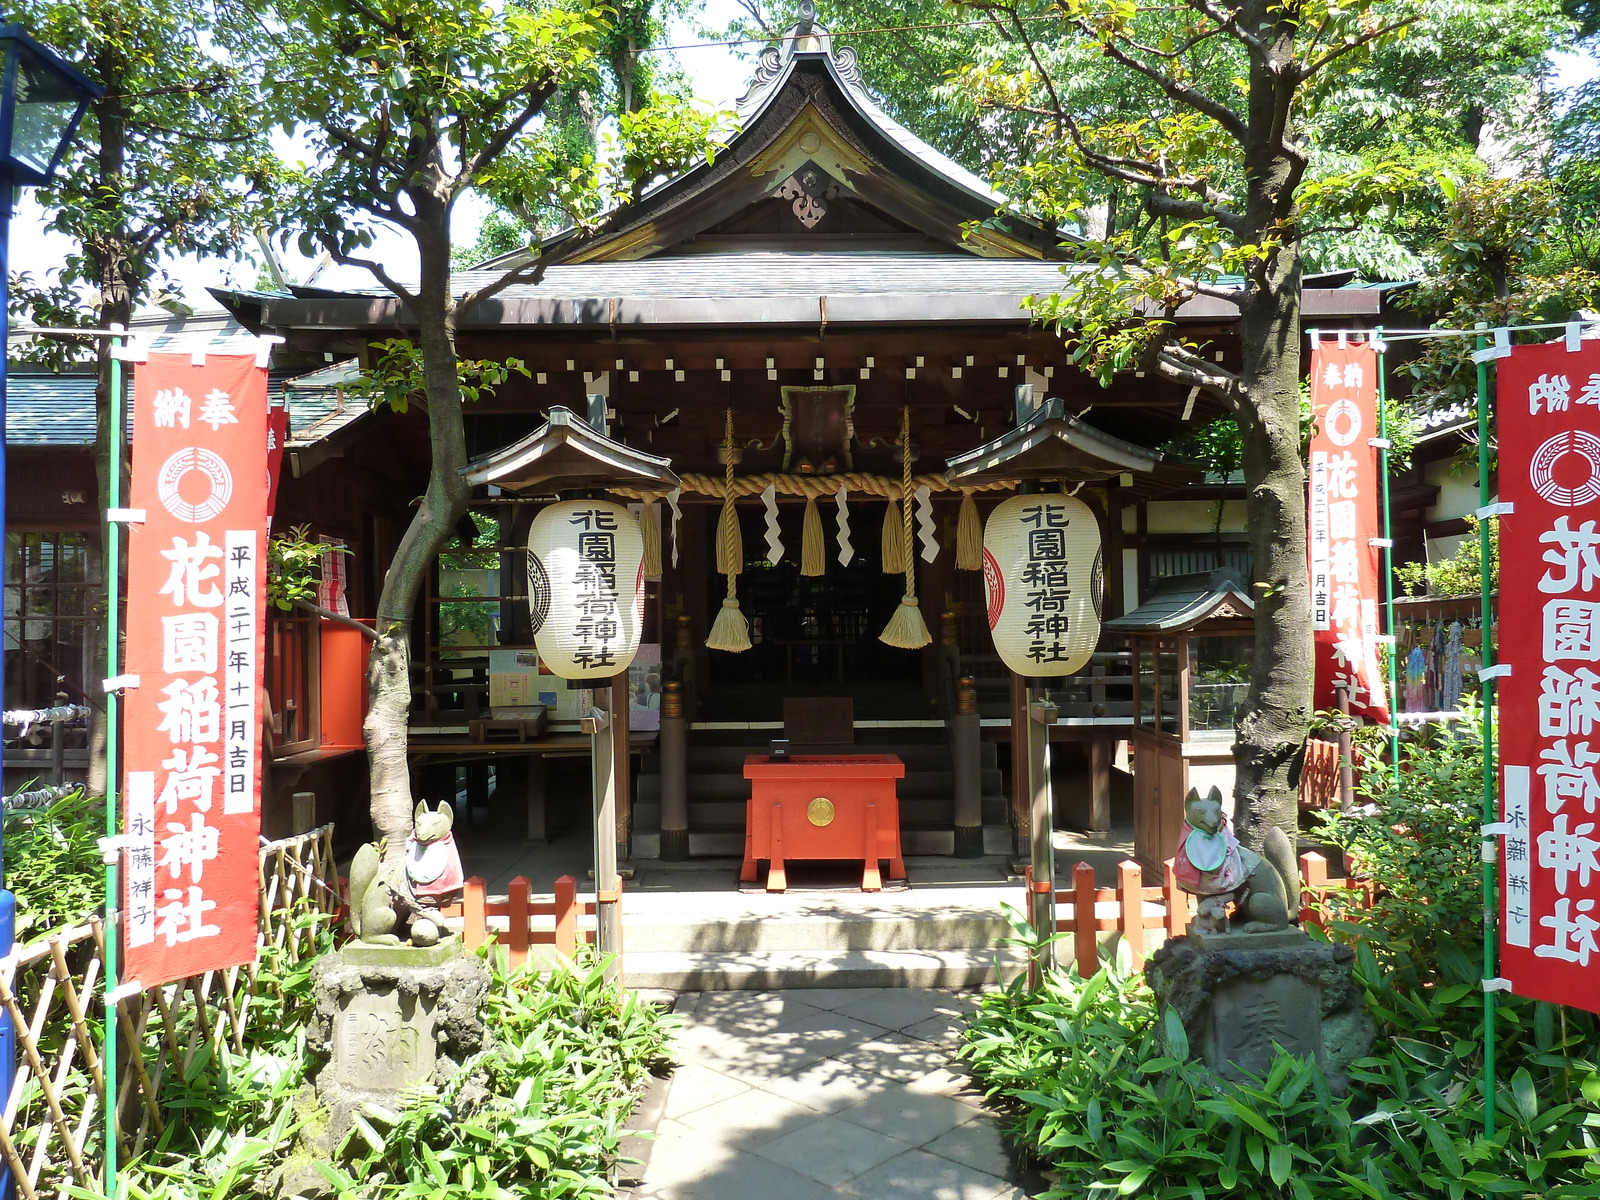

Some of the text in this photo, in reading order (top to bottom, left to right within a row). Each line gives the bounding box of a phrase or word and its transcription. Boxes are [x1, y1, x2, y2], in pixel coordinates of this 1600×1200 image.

[228, 545, 252, 794] 平成二十一年十一月吉日
[568, 509, 619, 670] 花園稲荷神社
[1019, 504, 1071, 664] 花園稲荷神社
[1326, 450, 1368, 709] 花園稲荷神社
[154, 529, 226, 947] 花園稲荷神社
[131, 812, 154, 925] 永藤祥子
